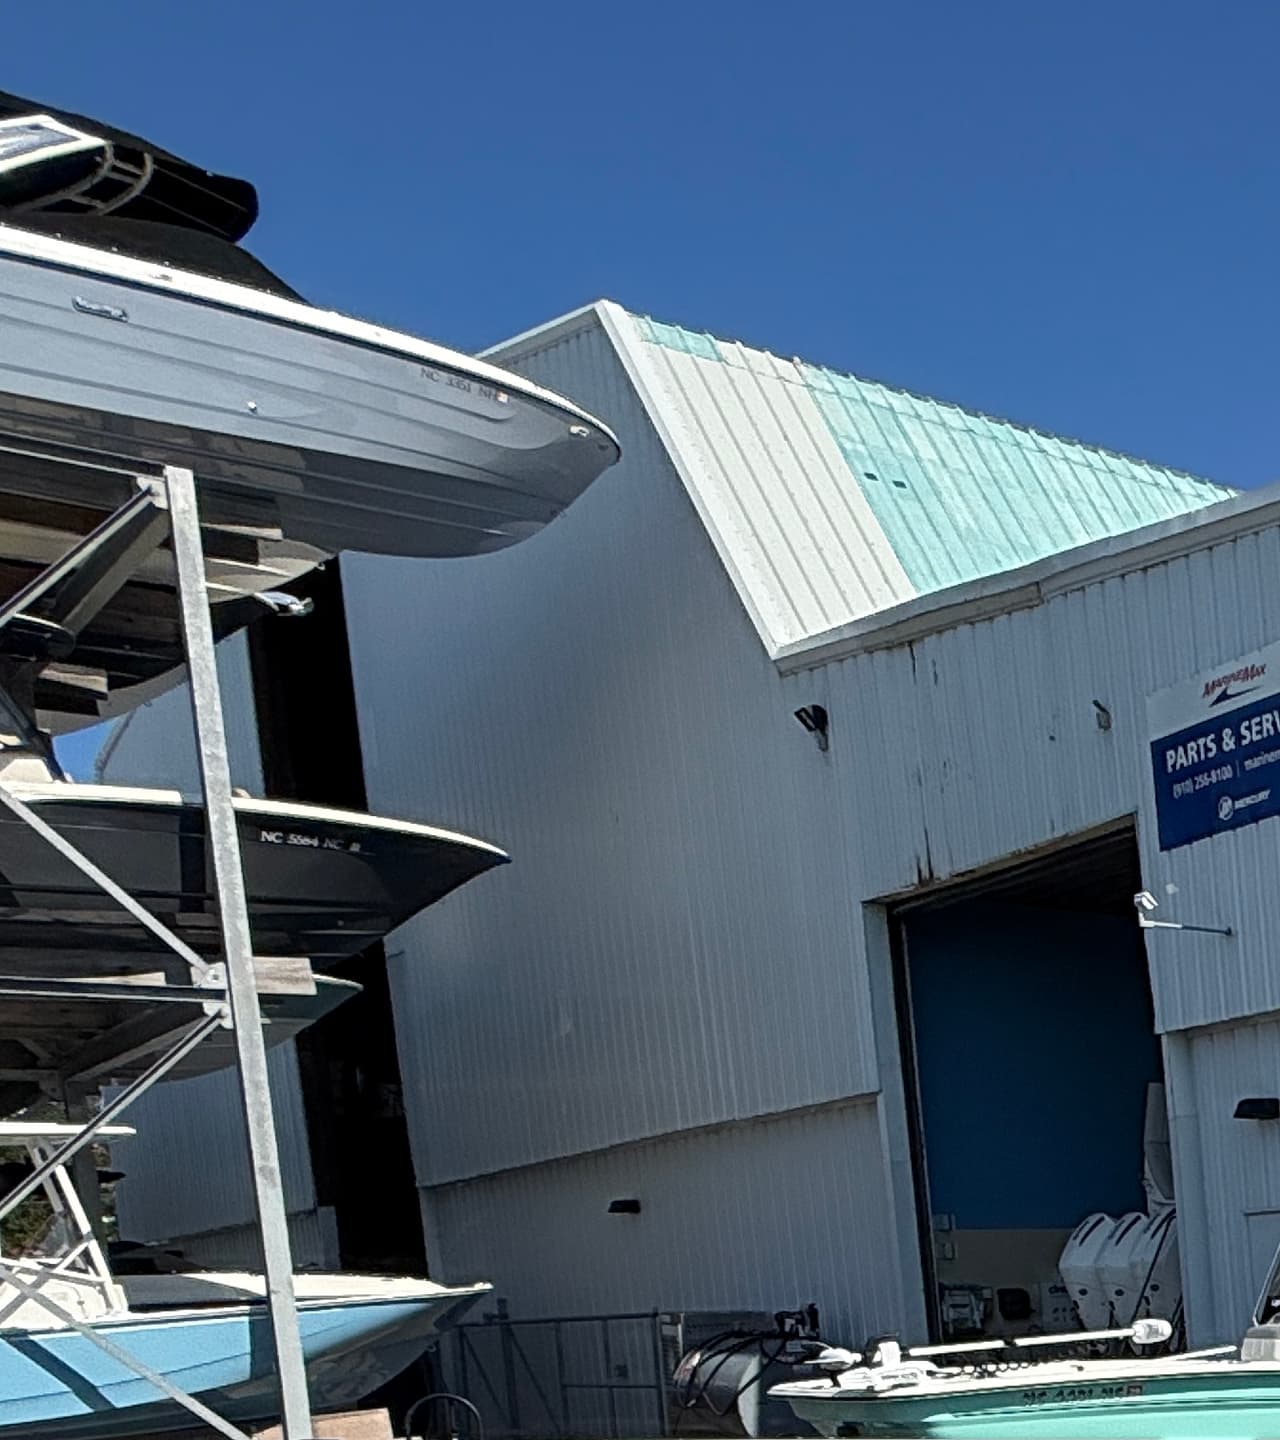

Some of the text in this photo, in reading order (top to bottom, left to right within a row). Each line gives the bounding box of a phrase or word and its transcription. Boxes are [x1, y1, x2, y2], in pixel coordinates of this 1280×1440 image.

[1165, 733, 1217, 774] PARTS
[1222, 727, 1236, 752] &
[260, 830, 284, 844] NC
